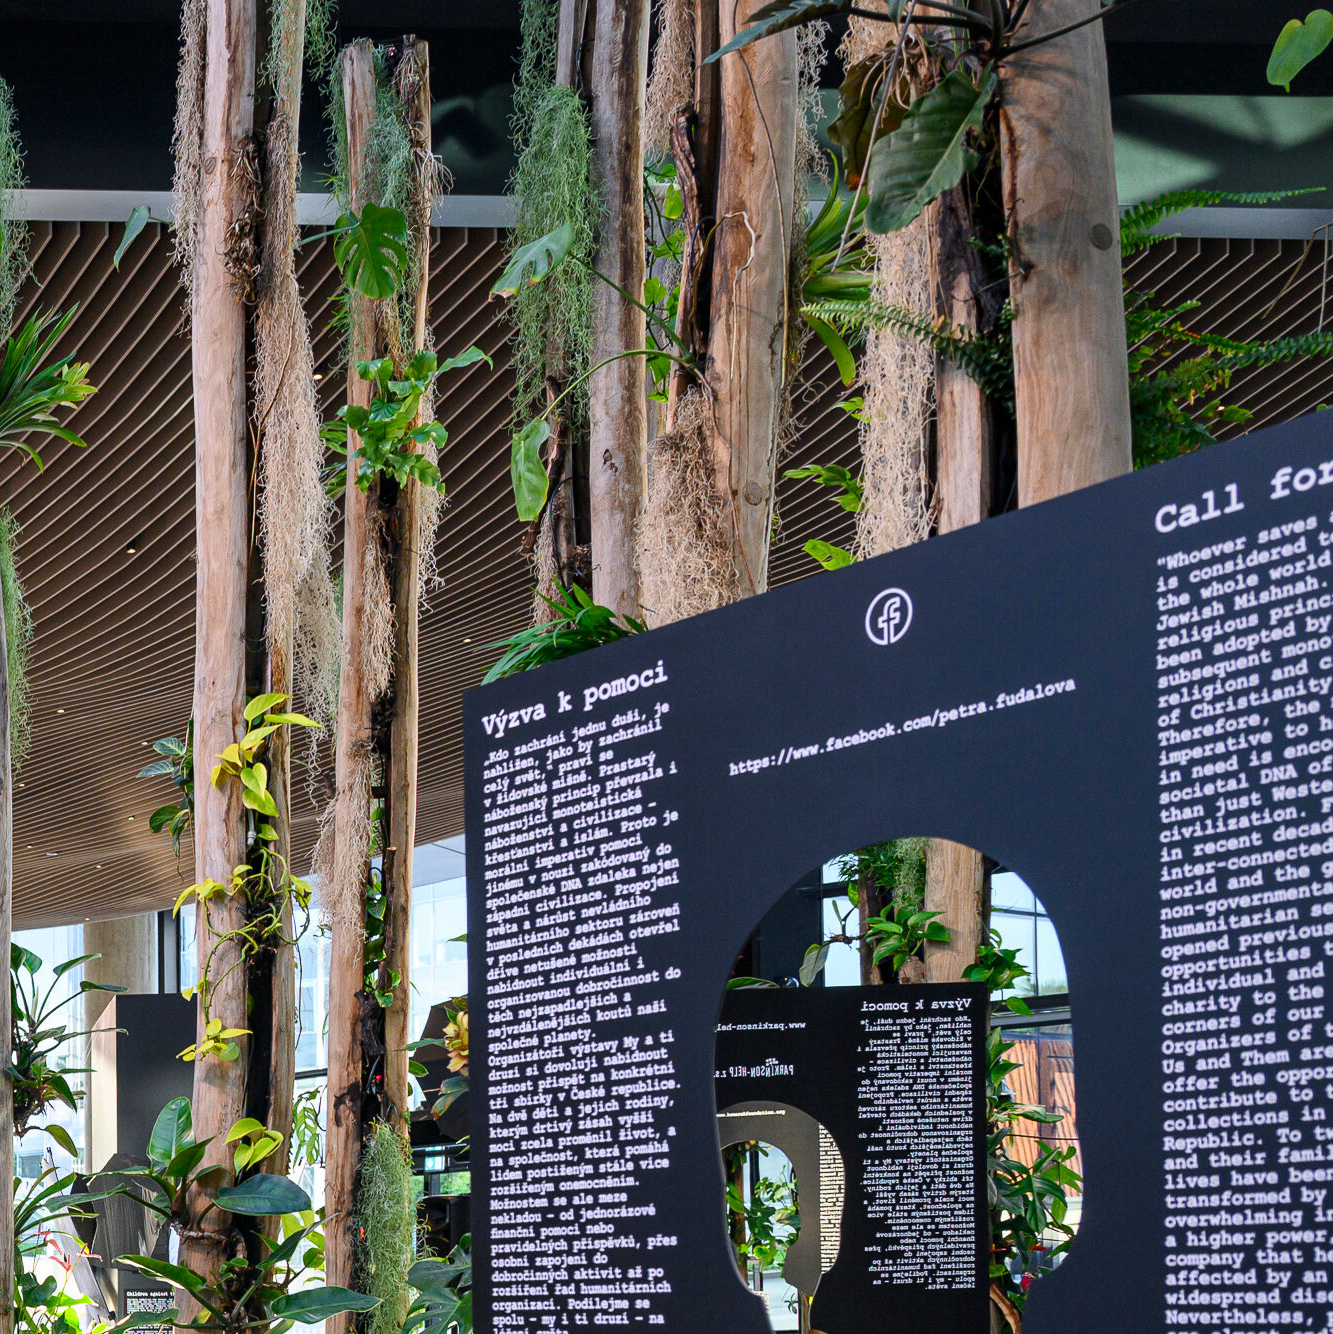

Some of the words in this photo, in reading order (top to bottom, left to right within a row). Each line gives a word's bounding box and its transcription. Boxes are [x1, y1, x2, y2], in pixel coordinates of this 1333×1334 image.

[1155, 483, 1245, 533] Call
[1156, 532, 1247, 573] "Whoever
[1257, 514, 1317, 545] saves
[1155, 597, 1225, 632] Jewish
[1233, 569, 1327, 611] Mishnah.
[481, 702, 546, 739] Výzva
[557, 690, 573, 713] k
[583, 660, 670, 712] pomoci
[1157, 707, 1181, 728] of
[1190, 669, 1332, 723] Christianity
[729, 678, 1076, 776] https://www.facebook.com/petra.fudalova
[534, 842, 595, 871] imperativ
[599, 831, 643, 856] pomoci
[486, 983, 570, 1012] organizovanou
[664, 964, 681, 980] do
[1161, 967, 1275, 997] individual
[1286, 960, 1324, 981] and
[1161, 1027, 1276, 1059] Organizers
[1287, 1023, 1312, 1042] of
[1164, 1206, 1303, 1231] overwhelming
[1165, 1308, 1312, 1325] Nevertheless,
